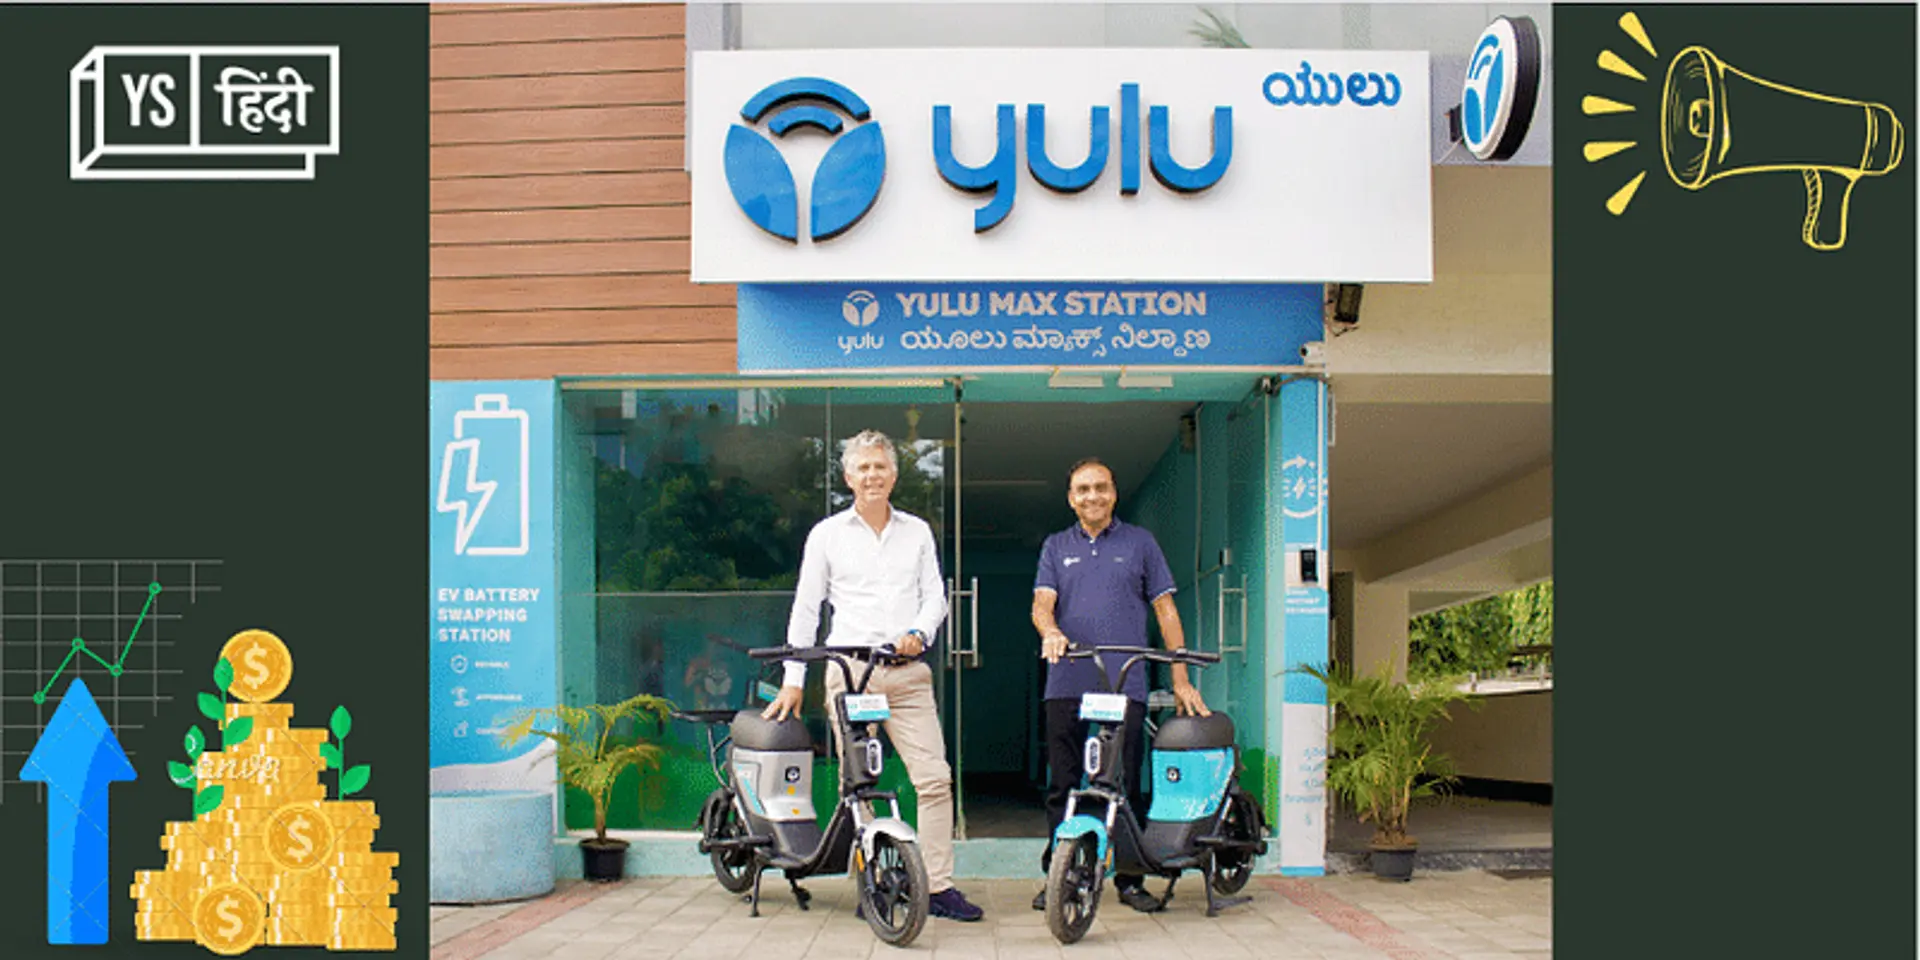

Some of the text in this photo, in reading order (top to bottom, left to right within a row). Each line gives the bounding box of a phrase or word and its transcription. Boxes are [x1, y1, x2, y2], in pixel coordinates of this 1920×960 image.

[1263, 61, 1401, 106] ಯುಲು
[932, 83, 1233, 233] yulu
[897, 291, 1207, 317] YULU MAX STATION
[838, 333, 884, 354] yulu
[438, 588, 540, 602] EV BATTERY
[437, 608, 528, 622] SWAPPING
[438, 628, 512, 643] STATION
